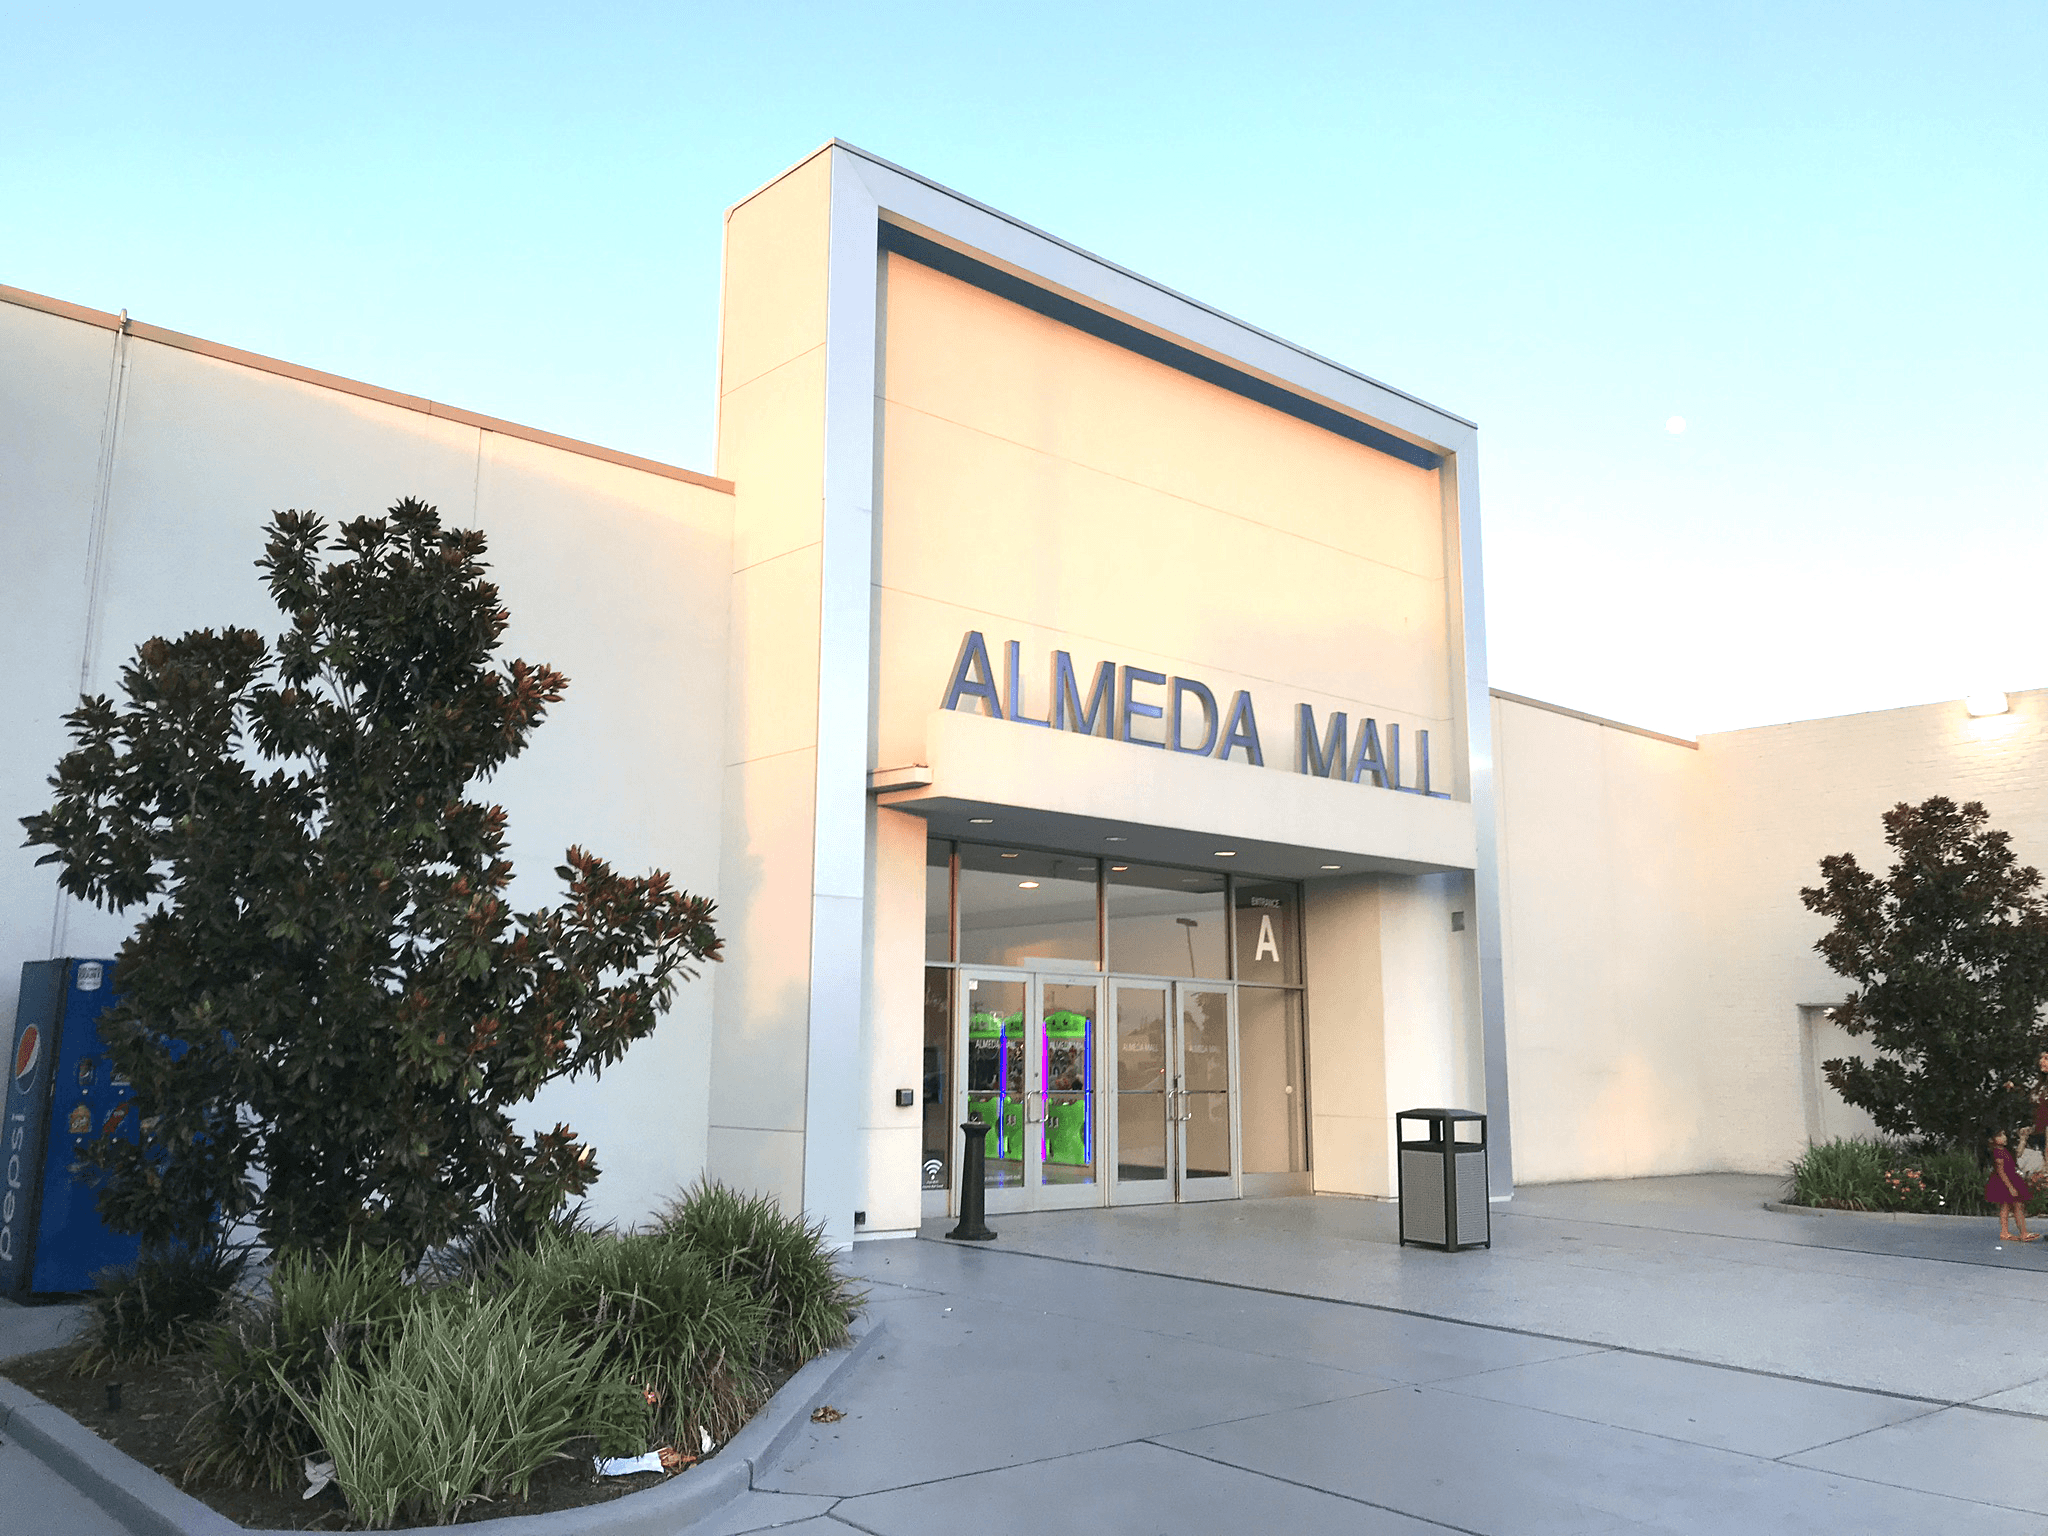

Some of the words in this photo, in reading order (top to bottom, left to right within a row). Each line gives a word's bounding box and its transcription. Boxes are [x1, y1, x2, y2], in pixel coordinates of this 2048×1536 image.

[940, 630, 1264, 767] ALMEDA
[1295, 703, 1451, 800] MALL
[1255, 914, 1279, 962] A
[0, 1113, 25, 1261] pepsi
